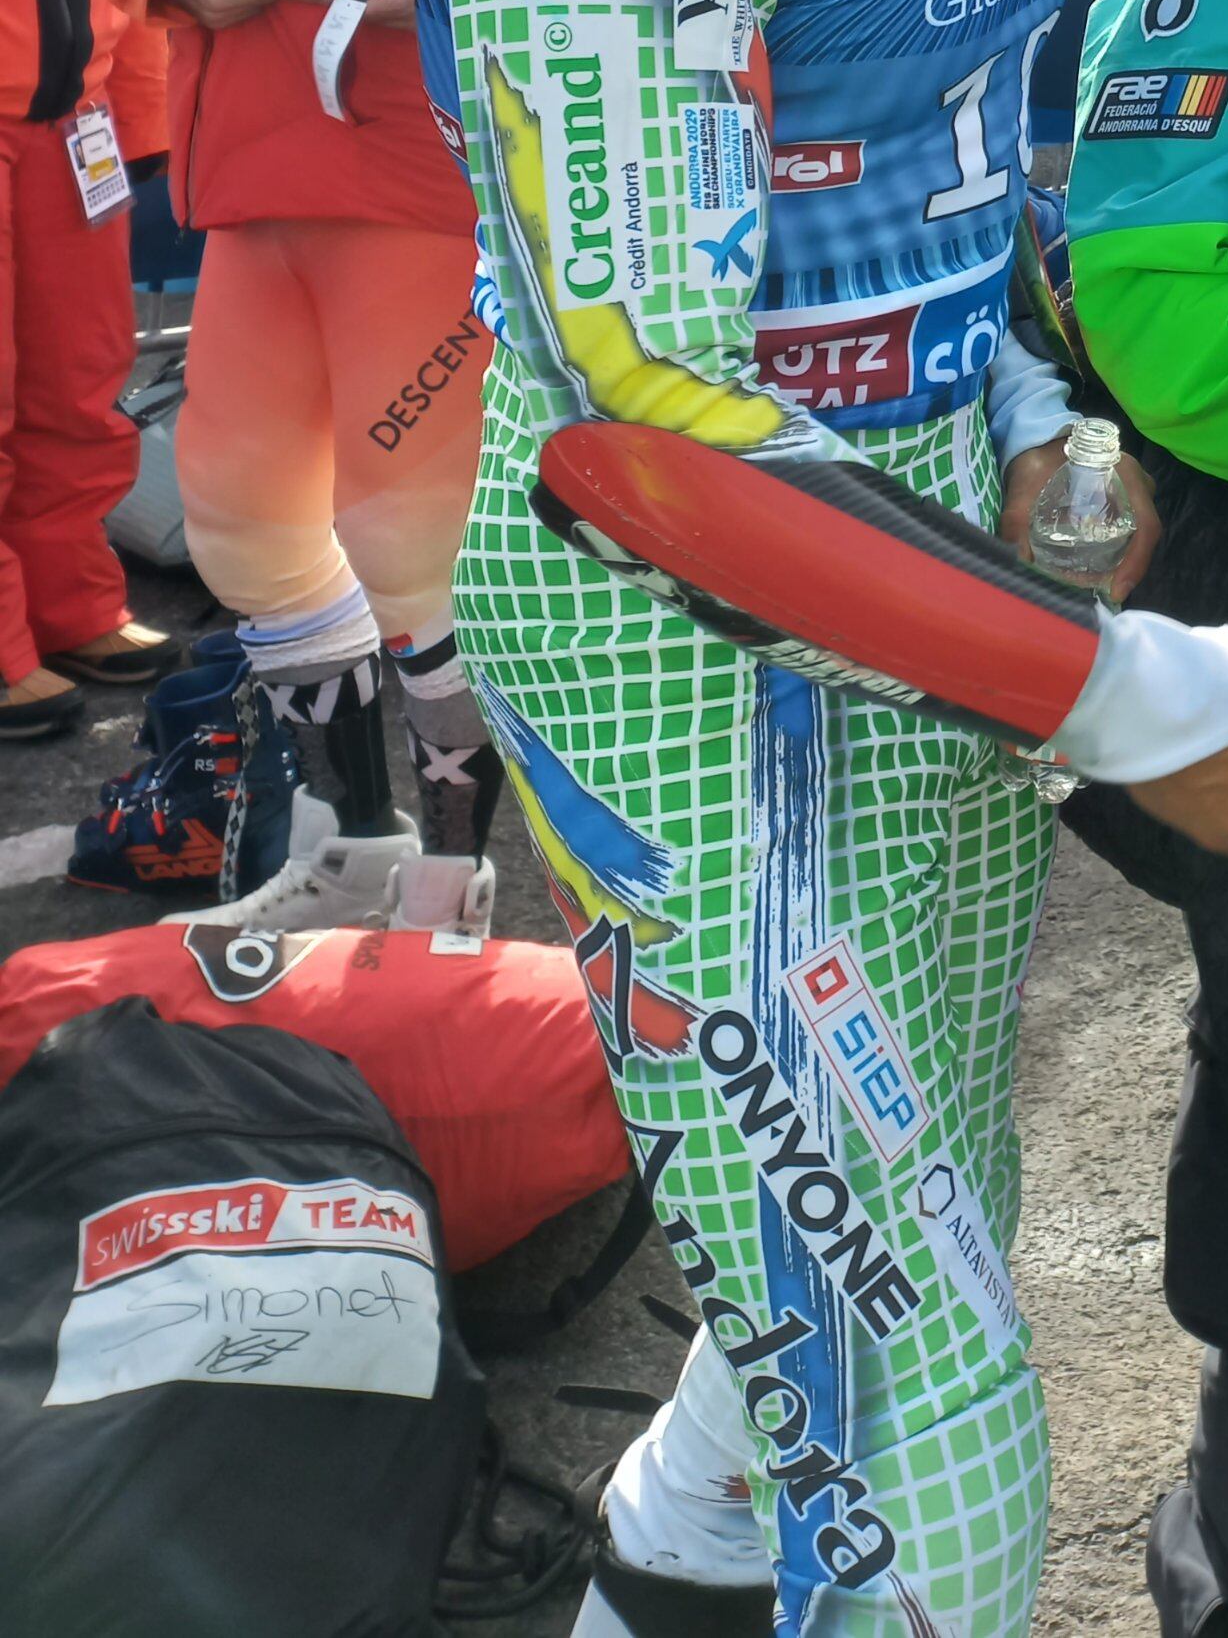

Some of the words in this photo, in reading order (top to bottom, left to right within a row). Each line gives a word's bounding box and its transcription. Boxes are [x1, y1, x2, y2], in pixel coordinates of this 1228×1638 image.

[684, 109, 699, 141] 2029
[700, 108, 709, 143] WORLD
[722, 109, 732, 146] TARTER
[1098, 118, 1158, 133] ANDORRANA
[1104, 101, 1157, 118] FEDERACIÓ
[545, 52, 615, 300] Creand
[702, 150, 710, 188] ALPINE
[707, 107, 720, 192] CHAMPIONSHIPS
[731, 110, 744, 194] GRANDVALIRA
[744, 132, 755, 186] CANDIDATE
[620, 161, 643, 232] Andorrà
[690, 144, 703, 210] ANDORRA
[726, 170, 736, 209] SOLDEU
[623, 238, 647, 290] Crèdit
[366, 309, 481, 453] DESCENT
[135, 859, 222, 881] LANG
[92, 1193, 264, 1266] swissski
[301, 1197, 416, 1238] TEAM
[619, 1112, 896, 1589] Andorra
